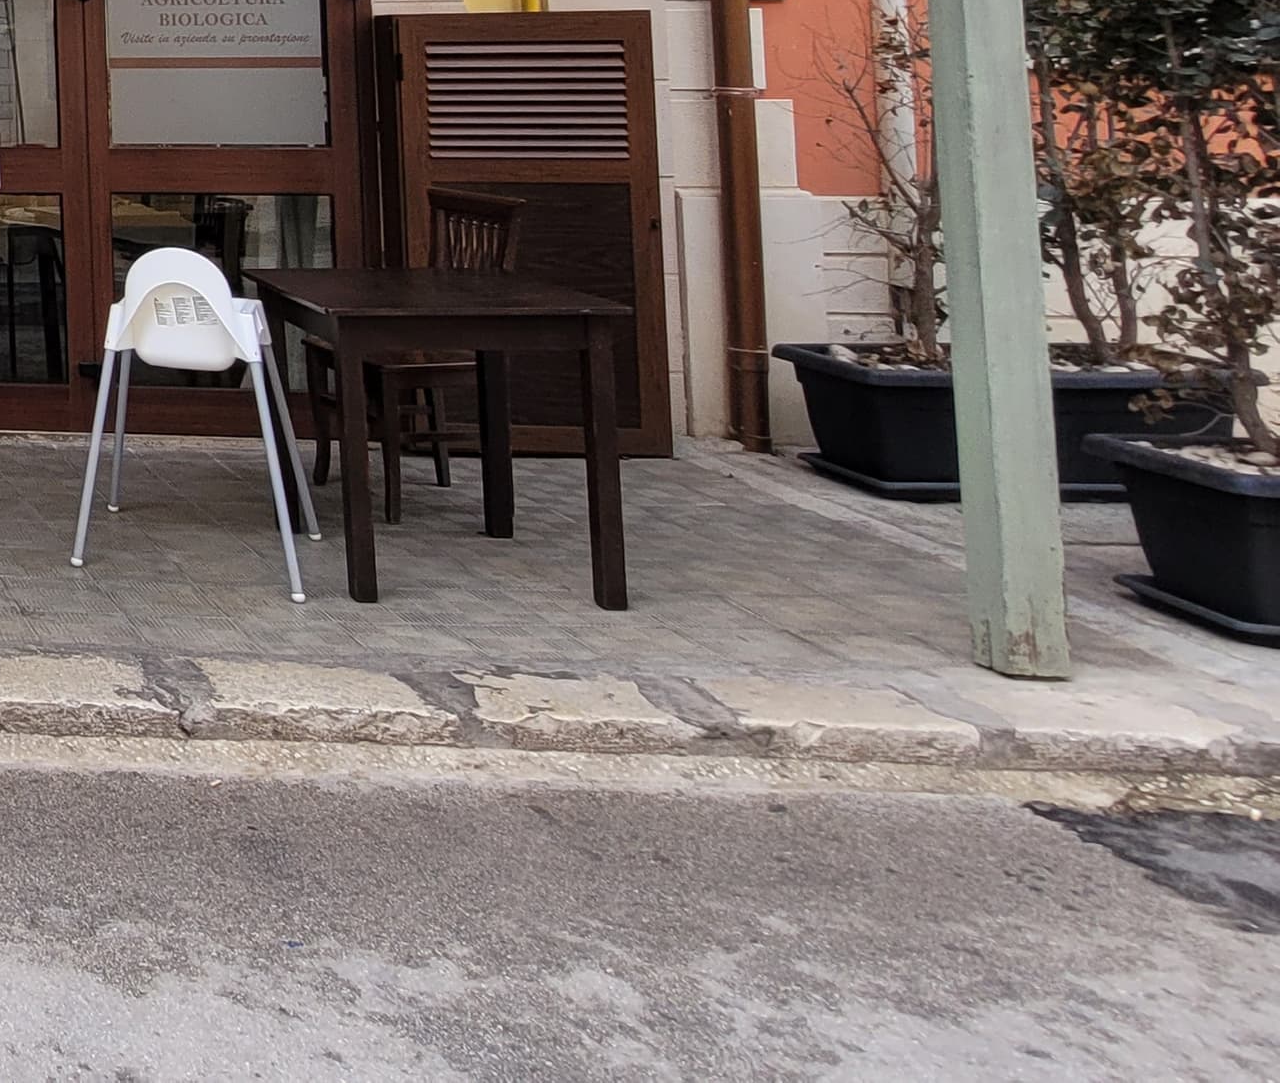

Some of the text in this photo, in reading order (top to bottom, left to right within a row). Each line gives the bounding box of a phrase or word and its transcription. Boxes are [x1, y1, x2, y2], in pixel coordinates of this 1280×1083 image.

[159, 12, 268, 27] BIOLOGICA
[121, 30, 310, 47] Visite in azienda su prenotazione
